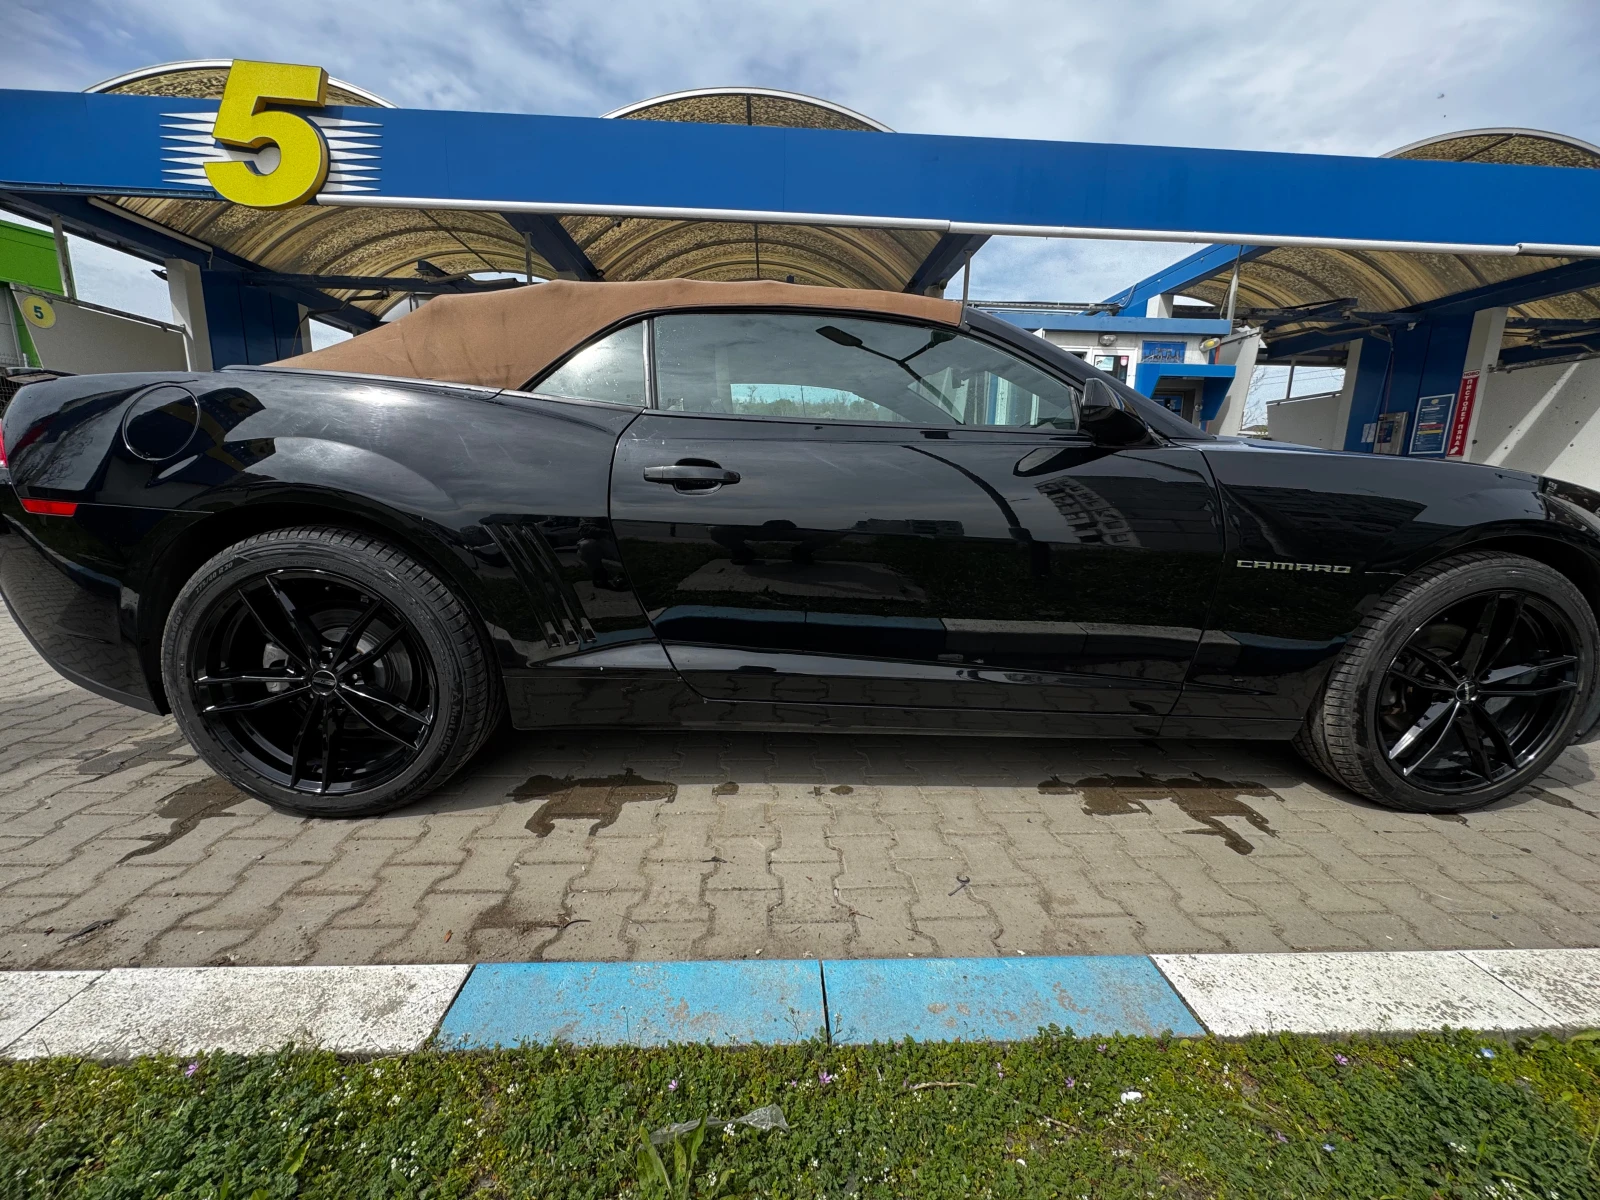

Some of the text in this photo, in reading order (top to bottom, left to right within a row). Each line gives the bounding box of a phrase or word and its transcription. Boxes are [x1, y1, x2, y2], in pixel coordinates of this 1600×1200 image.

[203, 59, 329, 210] 5
[34, 305, 44, 320] 5
[1454, 379, 1473, 446] ПИСТОЛЕТ ПЯНА
[1236, 560, 1351, 574] CAMARO
[438, 705, 461, 757] Matador
